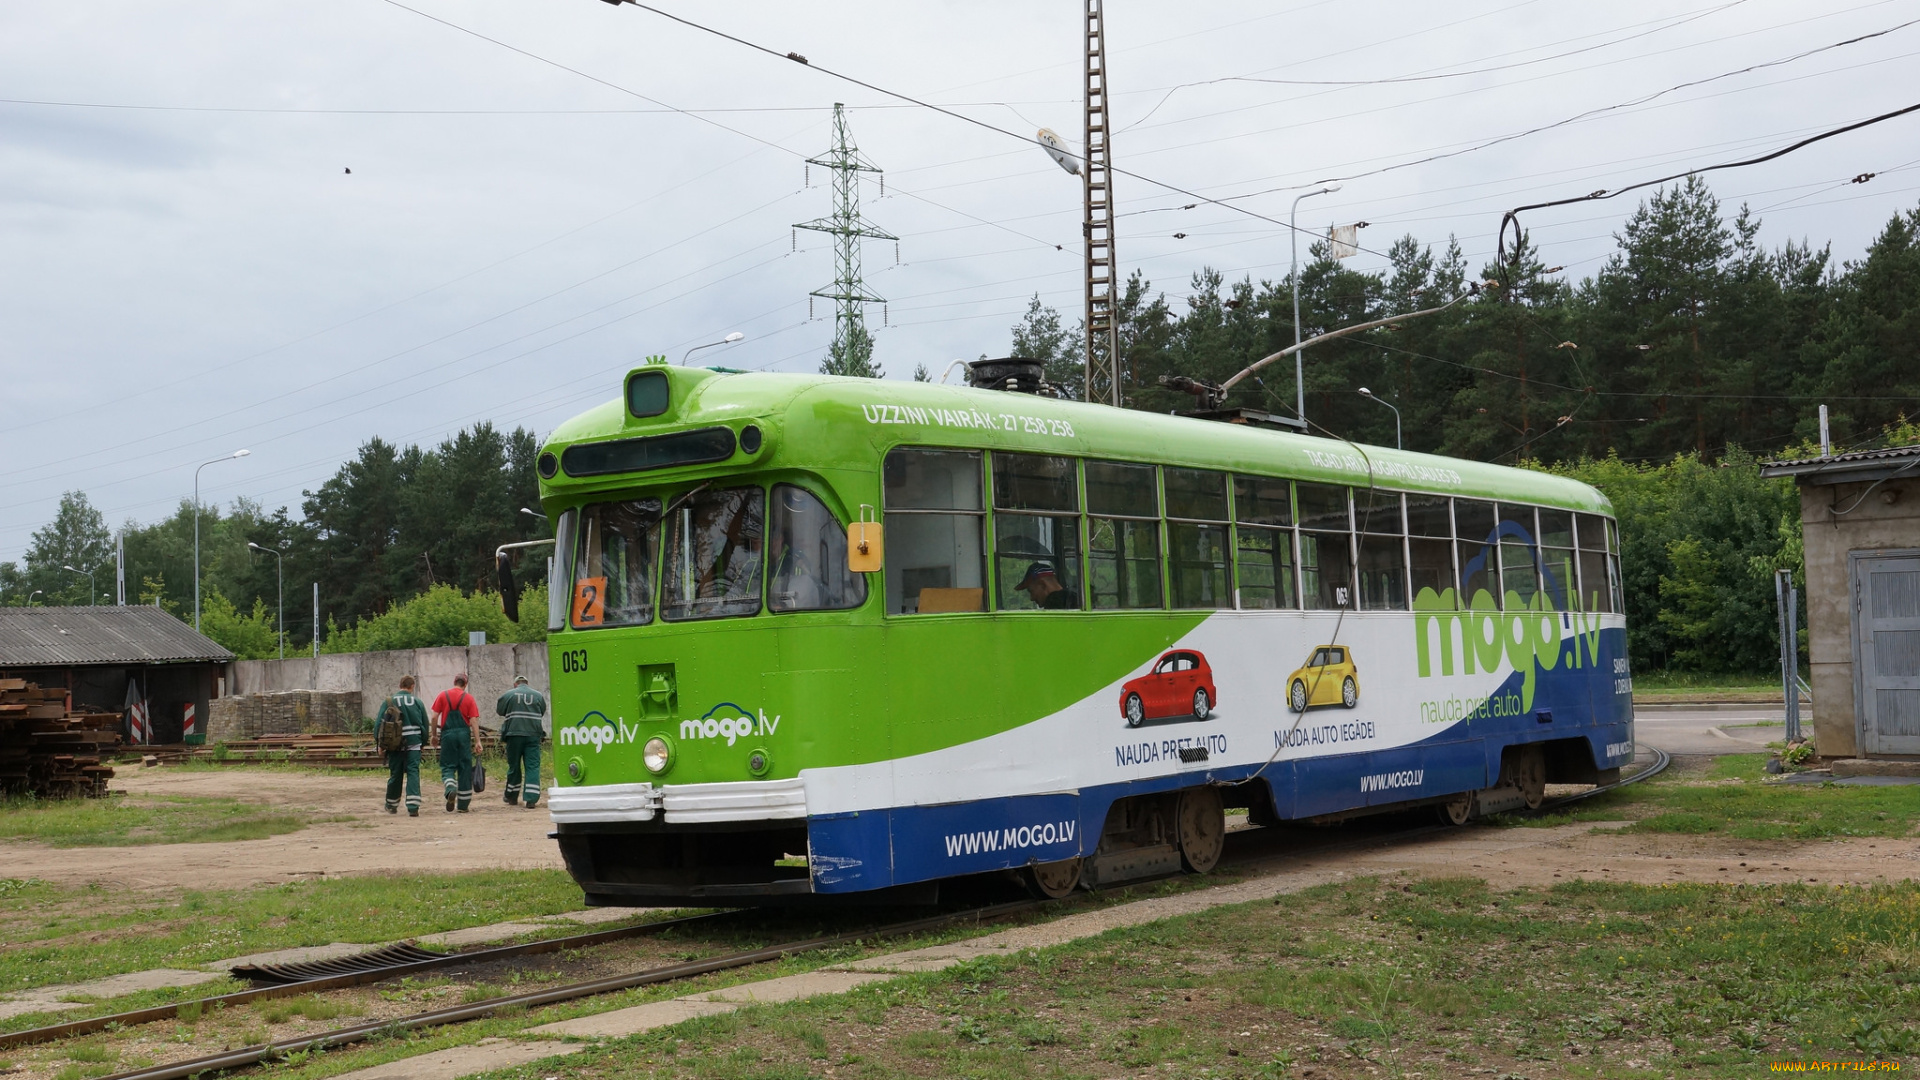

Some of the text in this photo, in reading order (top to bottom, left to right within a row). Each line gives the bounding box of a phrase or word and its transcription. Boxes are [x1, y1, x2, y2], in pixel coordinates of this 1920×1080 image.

[862, 404, 1075, 438] UZZINI VAIRĀK: 27 258 258
[1302, 449, 1343, 470] TAGAD
[1415, 465, 1451, 484] SAULES
[1447, 469, 1462, 485] 39
[580, 585, 597, 622] 2
[1336, 587, 1349, 605] 063
[1412, 557, 1600, 714] mogo.lv
[562, 649, 588, 673] 063
[393, 695, 415, 707] TU
[514, 692, 534, 706] TU
[1420, 688, 1521, 726] nauda pret auto
[560, 716, 639, 753] mogo.lv
[680, 707, 781, 747] mogo.lv
[1274, 718, 1376, 749] NAUDA AUTO IEGĀDEI
[1115, 741, 1160, 767] NAUDA
[1360, 769, 1424, 793] WWW.MOGO.LV
[944, 820, 1075, 857] WWW.MOGO.LV
